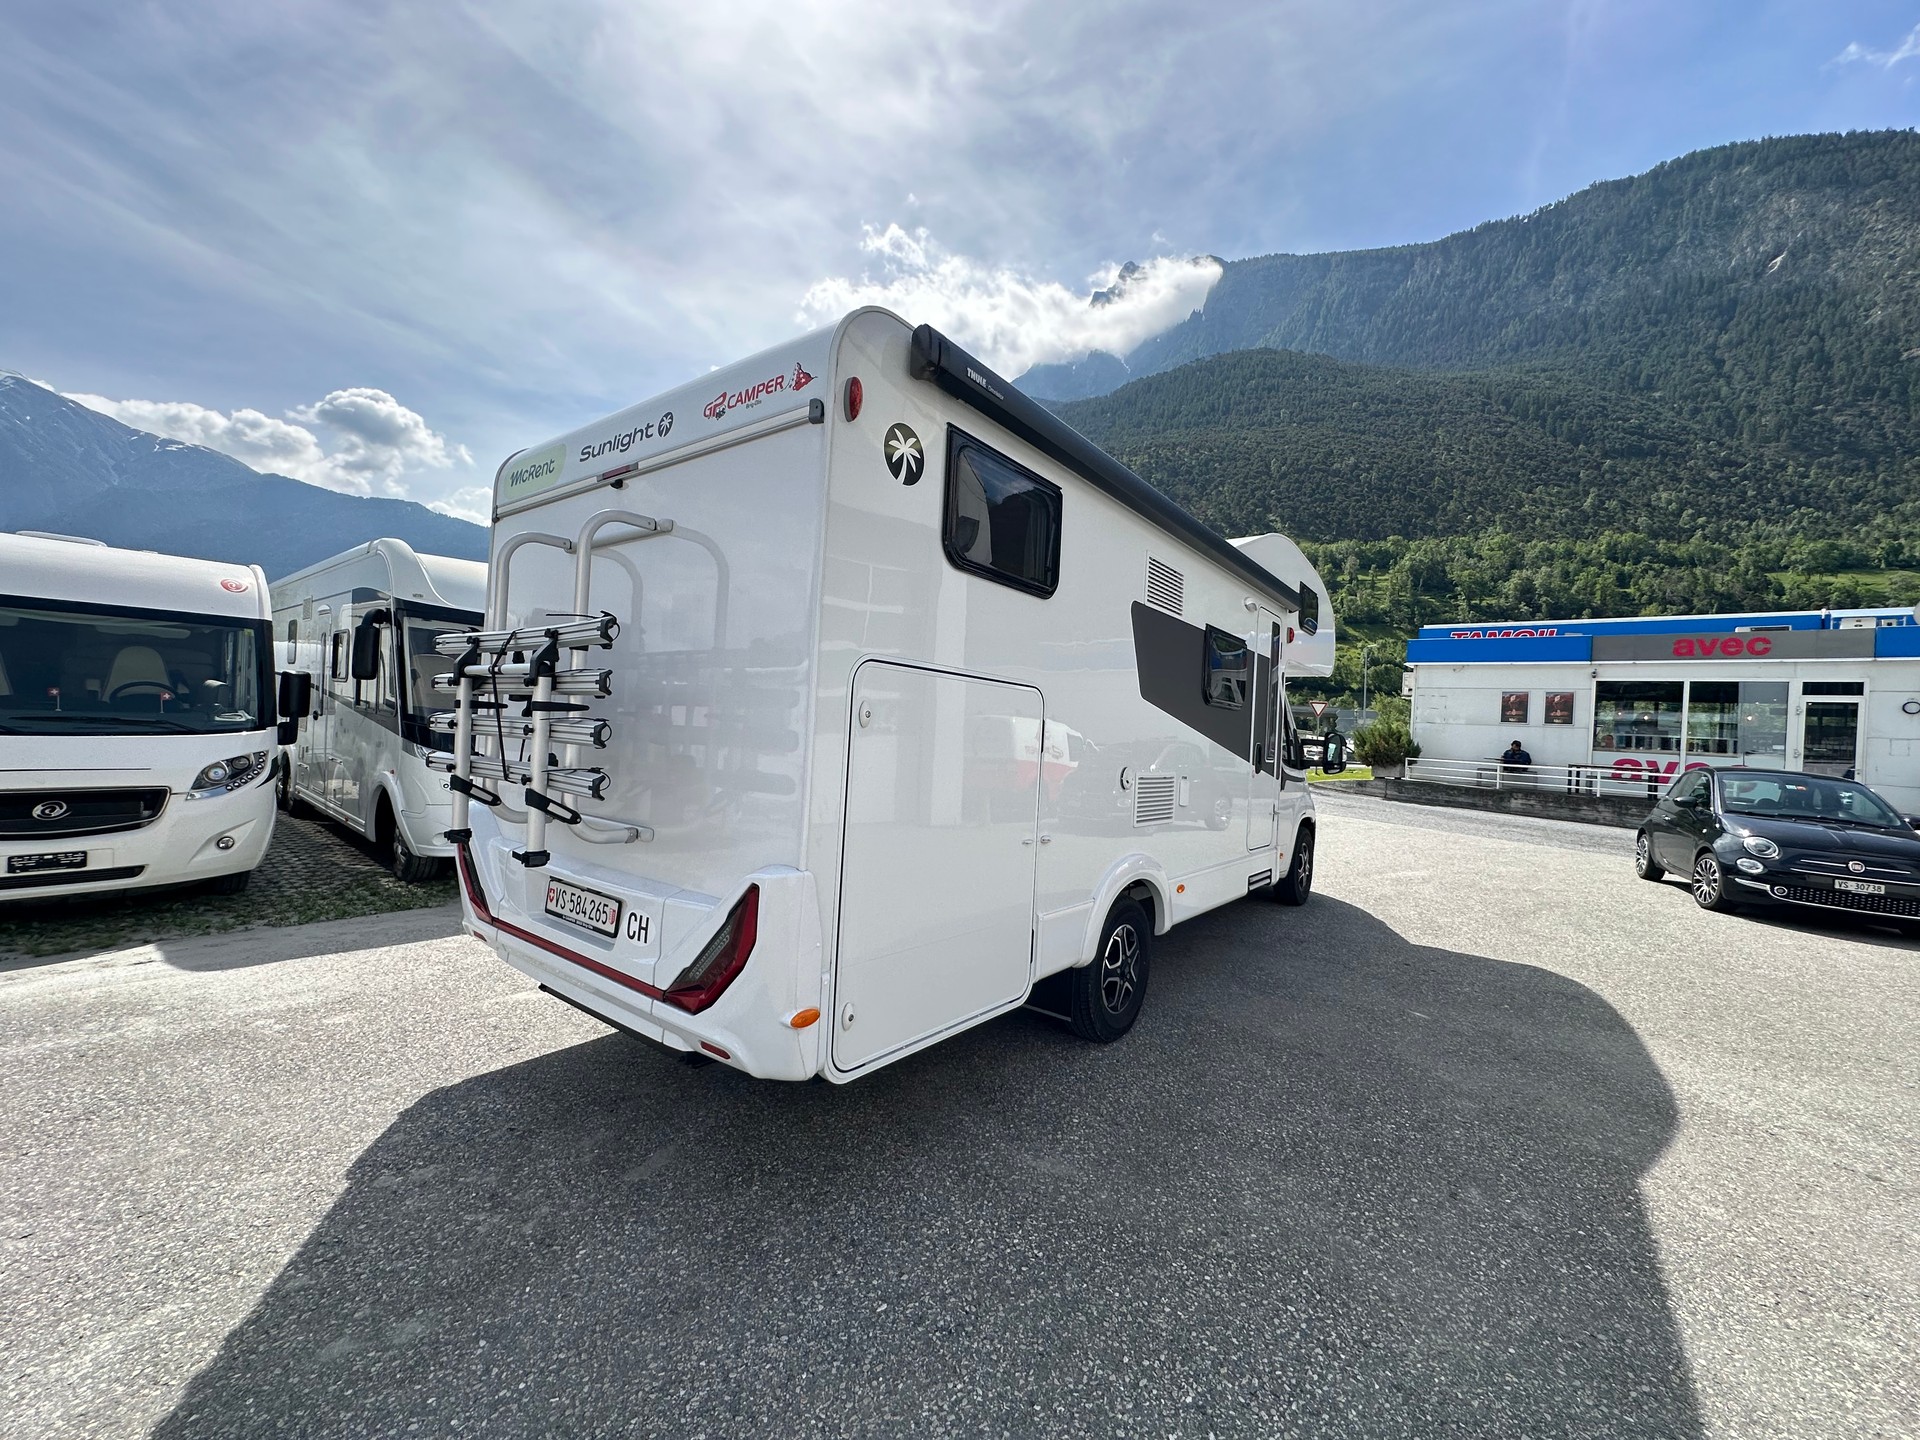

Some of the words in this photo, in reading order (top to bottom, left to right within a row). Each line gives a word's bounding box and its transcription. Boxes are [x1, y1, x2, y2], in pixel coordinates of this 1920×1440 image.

[728, 374, 785, 410] CAMPER
[579, 423, 654, 462] Sunlight
[510, 458, 555, 487] McRent
[1672, 636, 1773, 657] avec
[626, 911, 650, 944] CH
